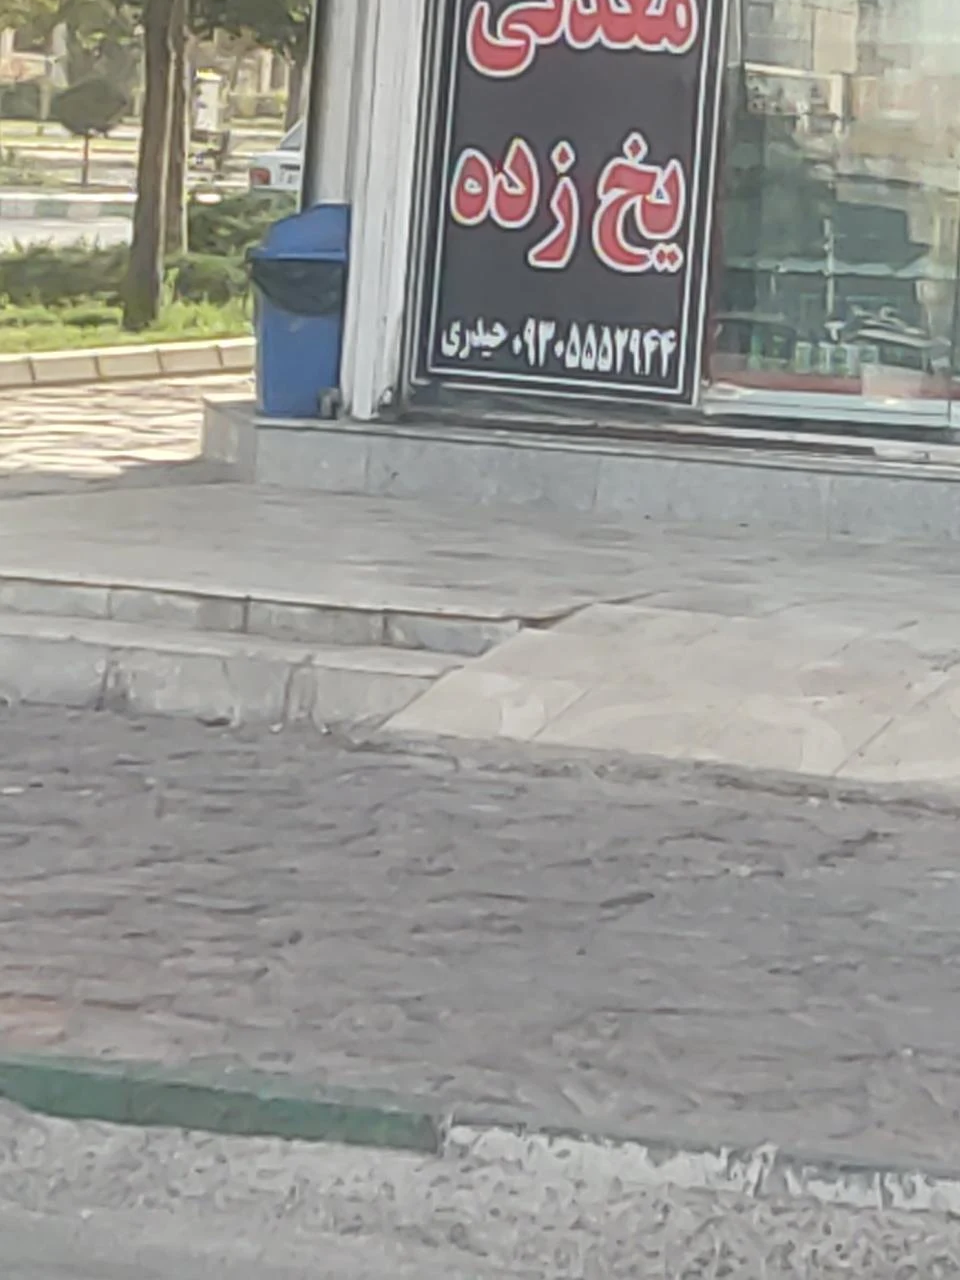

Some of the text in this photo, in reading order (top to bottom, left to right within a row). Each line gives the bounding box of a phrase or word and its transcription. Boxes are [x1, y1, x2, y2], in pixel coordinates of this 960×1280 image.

[450, 131, 687, 273] یخ زده
[441, 317, 509, 360] حیدری
